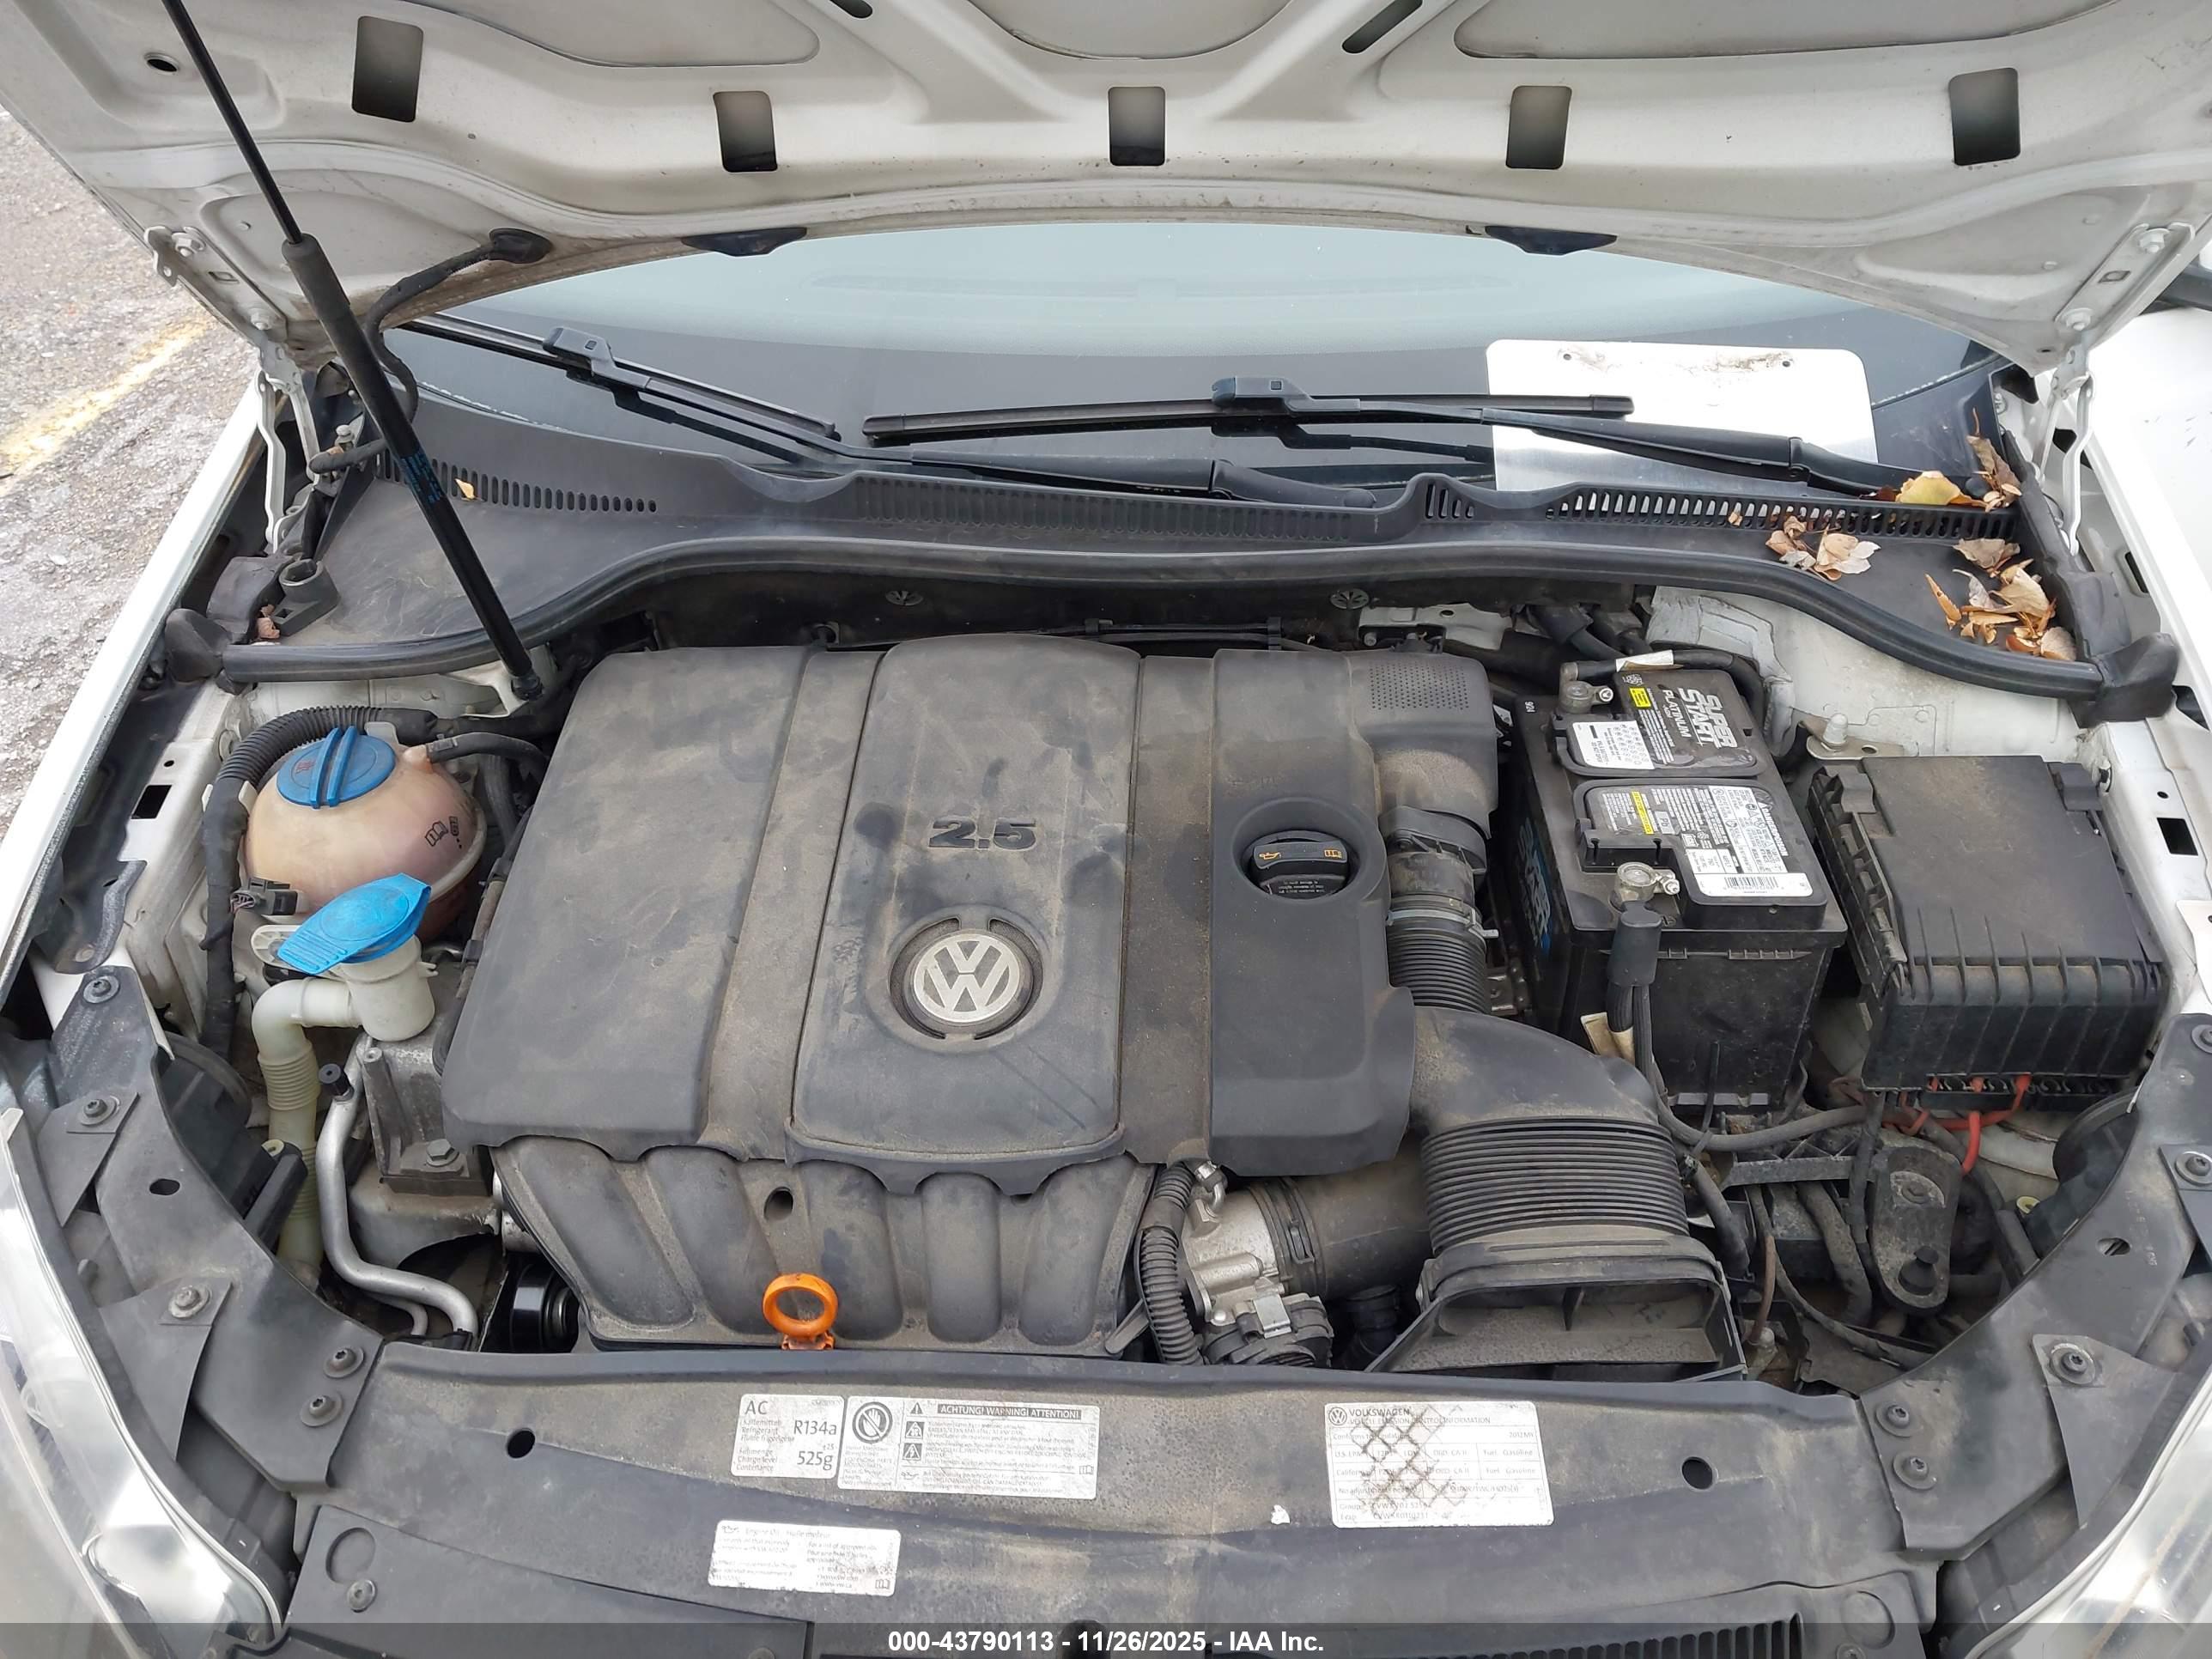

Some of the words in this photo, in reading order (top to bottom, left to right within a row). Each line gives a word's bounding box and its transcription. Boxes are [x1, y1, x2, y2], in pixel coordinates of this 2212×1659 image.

[1662, 690, 1692, 738] PLATINUM
[1677, 687, 1721, 749] START
[1700, 693, 1737, 749] SUPER
[928, 817, 1036, 850] 2.5
[744, 1401, 769, 1415] AC
[940, 1405, 984, 1416] ACHTUNG!
[986, 1407, 1029, 1417] WARNING!
[1030, 1409, 1079, 1419] ATTENTION!
[1349, 1407, 1410, 1417] VOLKSWAGEN
[793, 1419, 837, 1436] R134a
[797, 1450, 834, 1471] 525g
